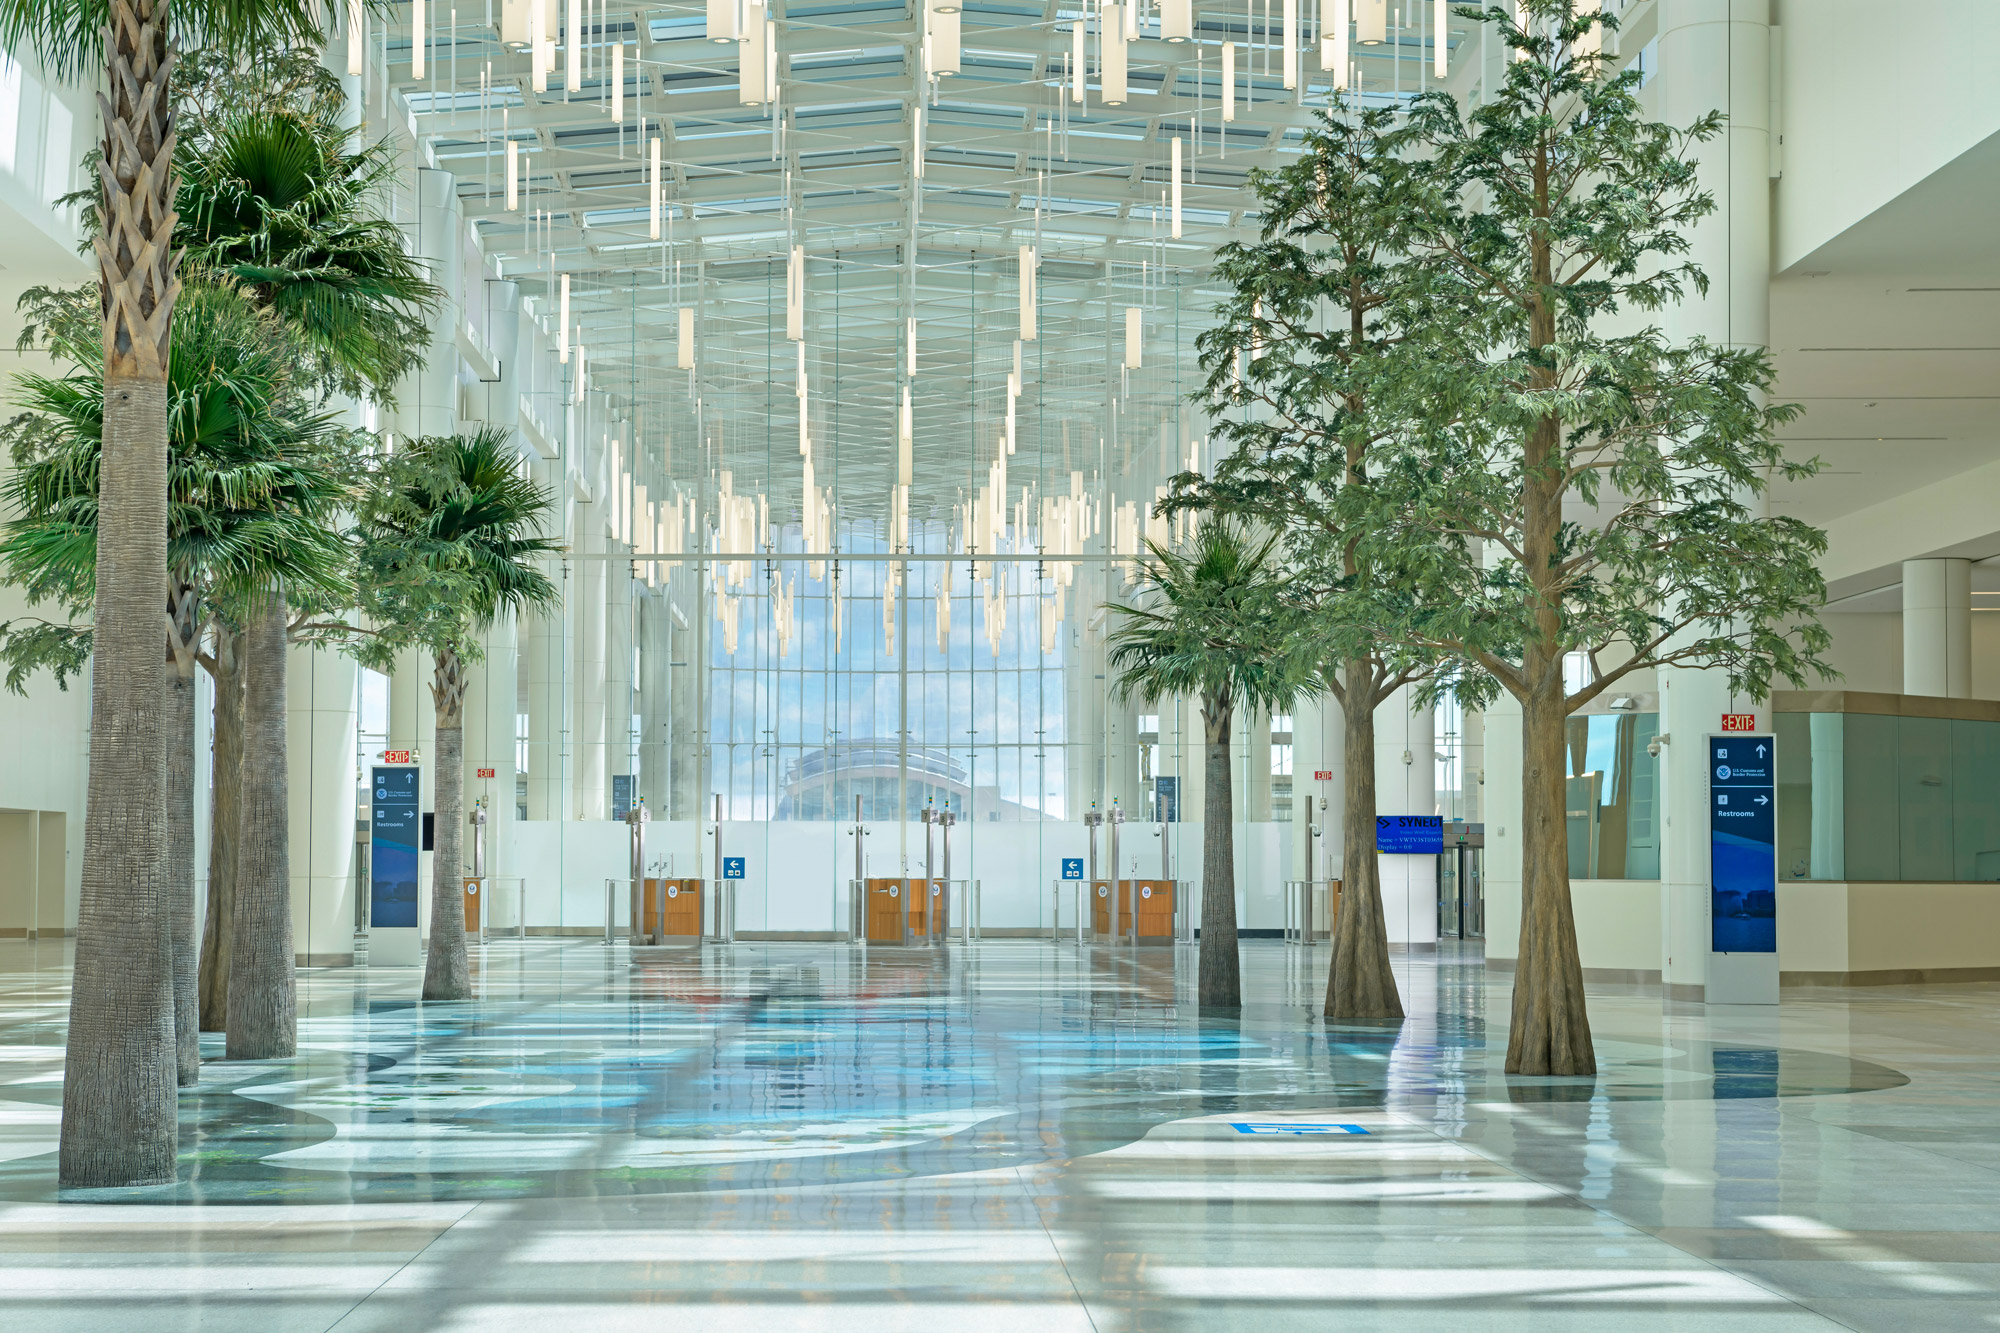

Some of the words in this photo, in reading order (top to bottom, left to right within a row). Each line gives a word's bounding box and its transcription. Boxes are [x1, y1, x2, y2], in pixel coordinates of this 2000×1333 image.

[1727, 715, 1751, 730] EXIT
[389, 751, 406, 763] EXIT
[480, 769, 493, 777] EXIT
[1317, 771, 1330, 780] EXIT
[1399, 817, 1443, 827] SYNECT
